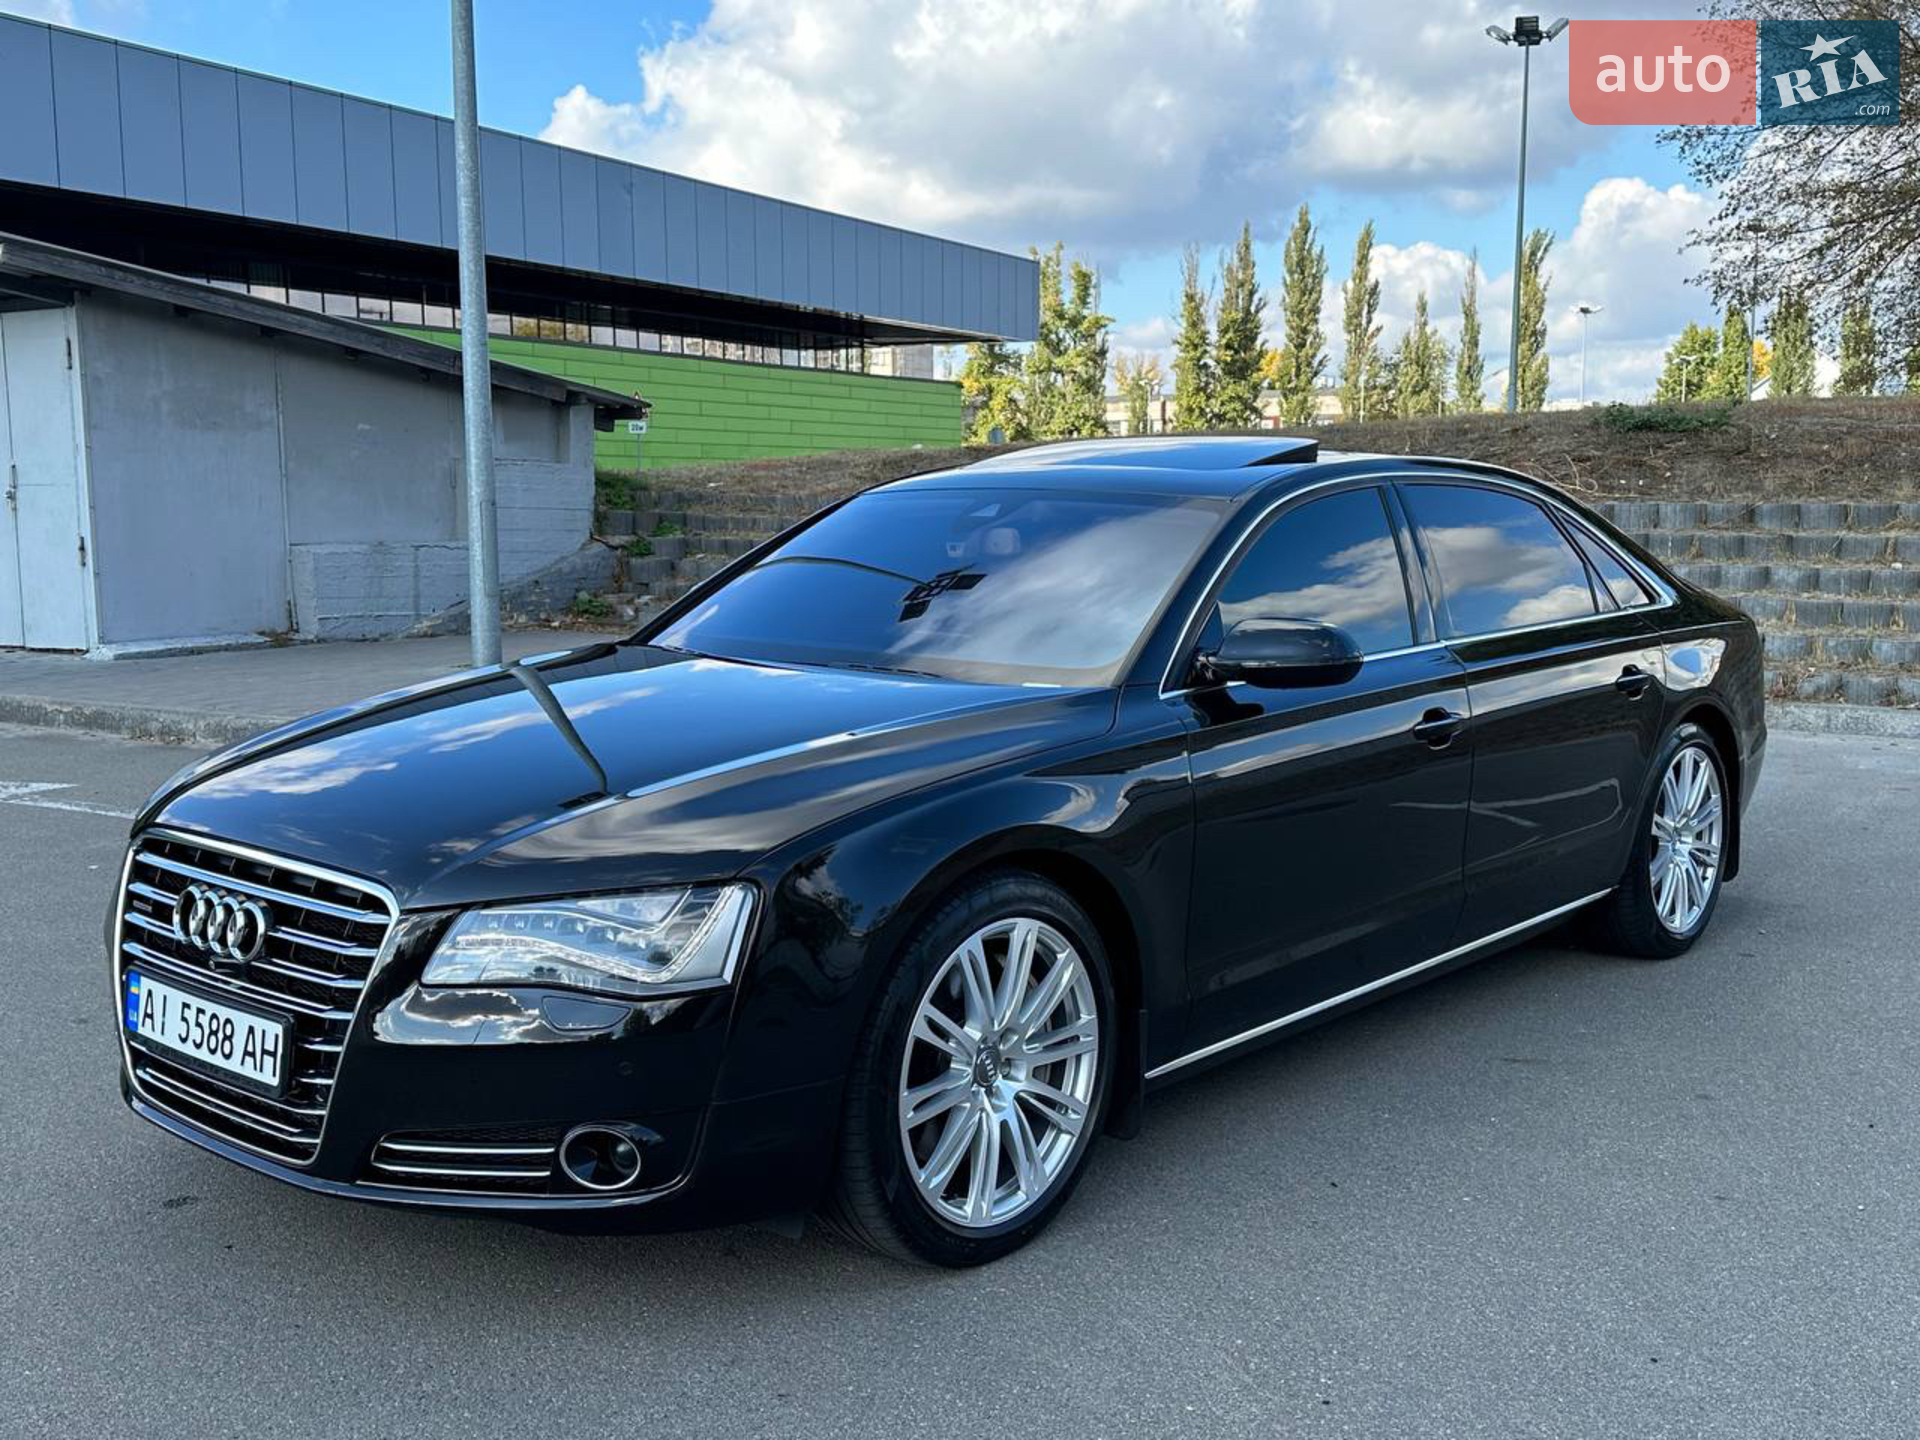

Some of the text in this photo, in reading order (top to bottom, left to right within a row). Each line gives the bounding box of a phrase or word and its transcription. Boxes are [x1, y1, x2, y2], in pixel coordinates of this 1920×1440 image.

[141, 988, 167, 1036] AI
[178, 1001, 235, 1061] 5588
[240, 1025, 280, 1078] AH
